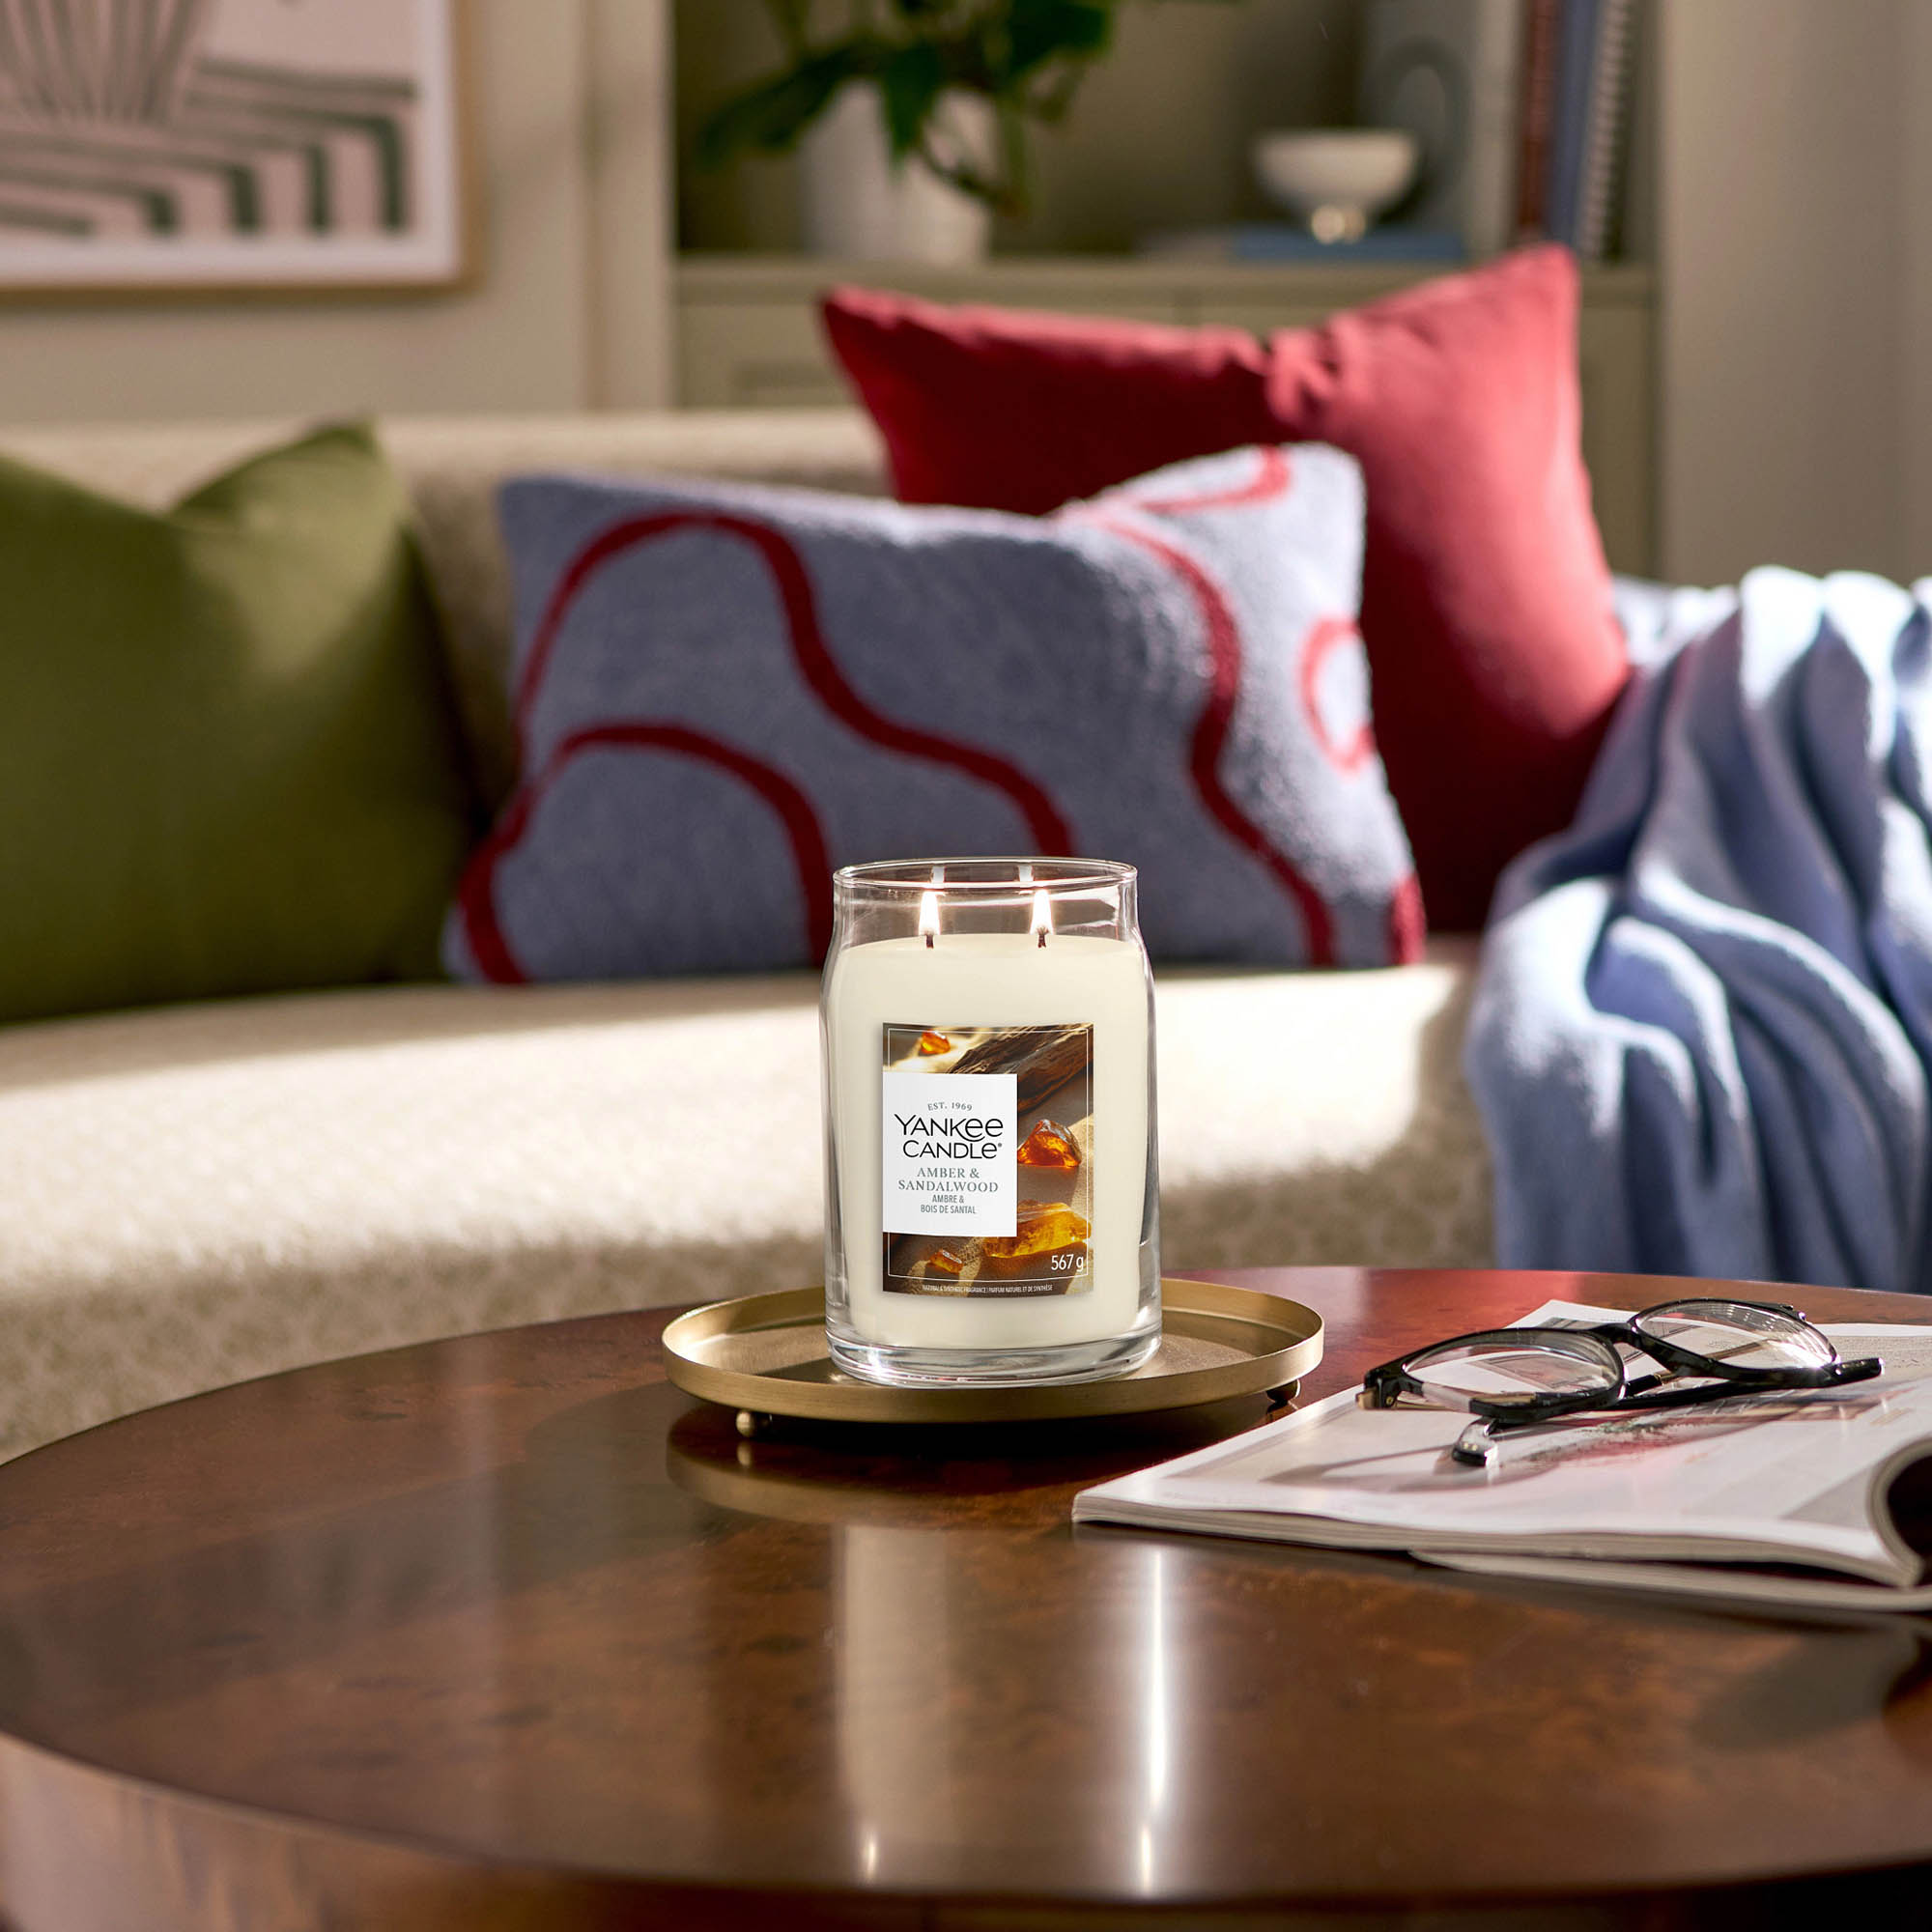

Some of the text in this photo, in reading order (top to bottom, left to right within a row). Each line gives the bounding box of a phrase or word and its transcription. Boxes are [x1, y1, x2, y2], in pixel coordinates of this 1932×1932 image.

[927, 1101, 973, 1111] EST. 1969
[917, 1167, 980, 1179] AMBER &
[898, 1179, 999, 1193] SANDALWOOD
[932, 1194, 964, 1204] AMBRE &
[921, 1204, 976, 1214] BOIS DE SANTAL
